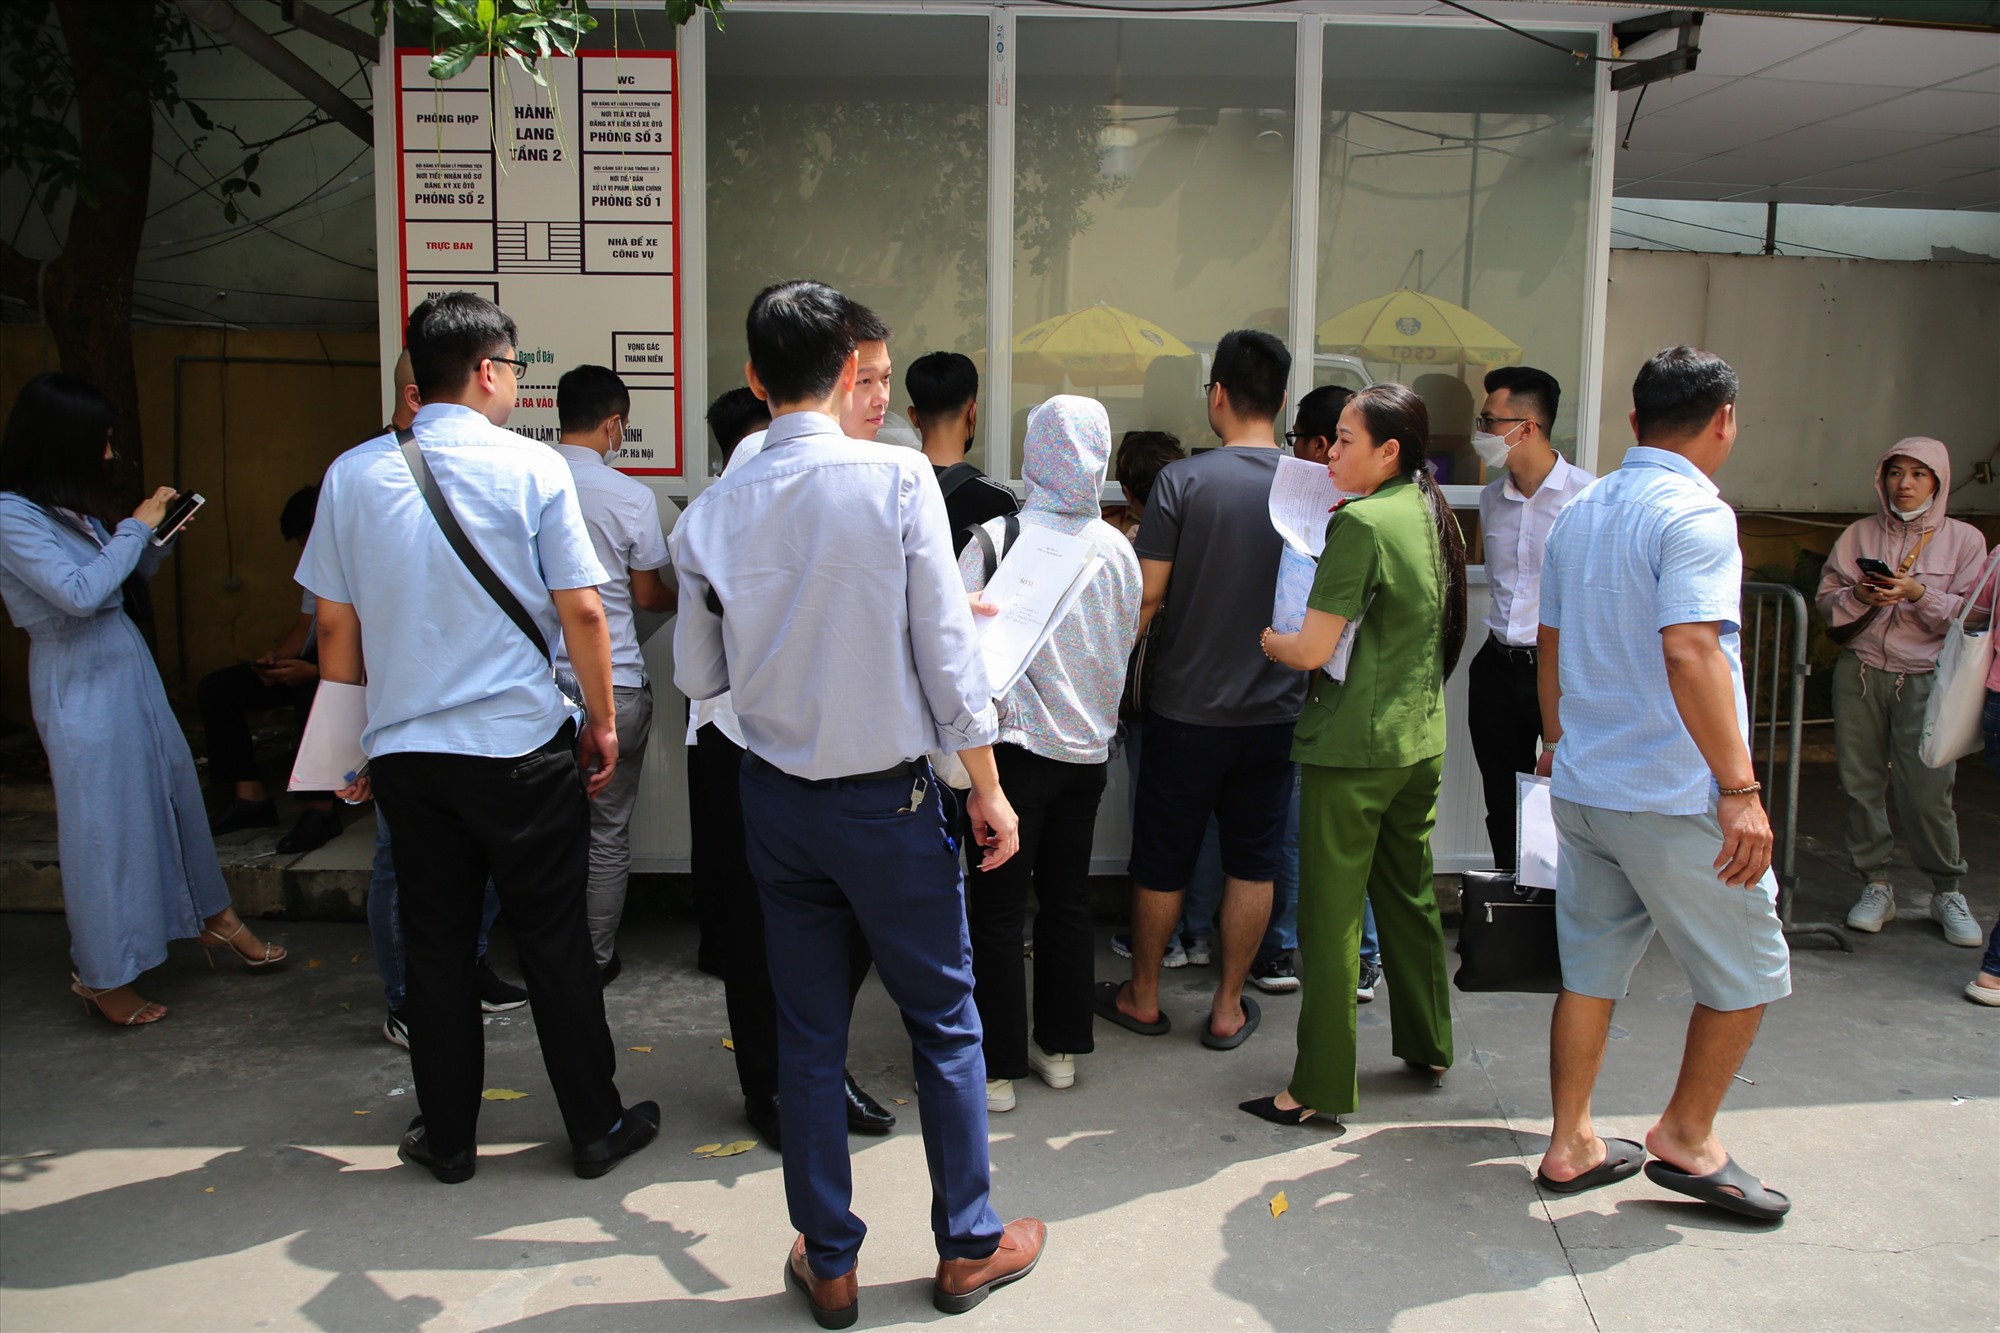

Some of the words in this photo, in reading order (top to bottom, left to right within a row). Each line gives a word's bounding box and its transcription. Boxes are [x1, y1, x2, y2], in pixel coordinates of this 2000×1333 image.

[617, 76, 635, 85] WC
[514, 104, 556, 119] HÀNH
[416, 112, 454, 123] PHÒNG
[457, 114, 479, 125] HỌP
[516, 128, 554, 140] LANG
[590, 129, 631, 142] PHÒNG
[635, 129, 651, 142] SỐ
[654, 132, 662, 142] 3
[509, 144, 548, 161] TẦNG
[552, 149, 562, 161] 2
[415, 192, 454, 204] PHÒNG
[458, 191, 474, 204] SỐ
[477, 194, 485, 204] 2
[592, 194, 632, 206] PHÒNG
[636, 194, 652, 207] SỐ
[655, 197, 661, 207] 1
[426, 241, 451, 251] TRỰC
[453, 242, 473, 250] BAN
[608, 237, 628, 246] NHÀ
[646, 238, 658, 247] XE
[612, 249, 639, 258] CÔNG
[641, 251, 654, 260] VỤ
[627, 343, 645, 352] VỌNG
[646, 342, 660, 350] GÁC
[647, 354, 663, 362] NIÊN
[522, 398, 534, 408] RA
[536, 396, 553, 408] VÀO
[535, 425, 554, 441] LÀM
[622, 425, 642, 442] HÍNH
[630, 448, 640, 458] Hà
[641, 448, 654, 460] Nội
